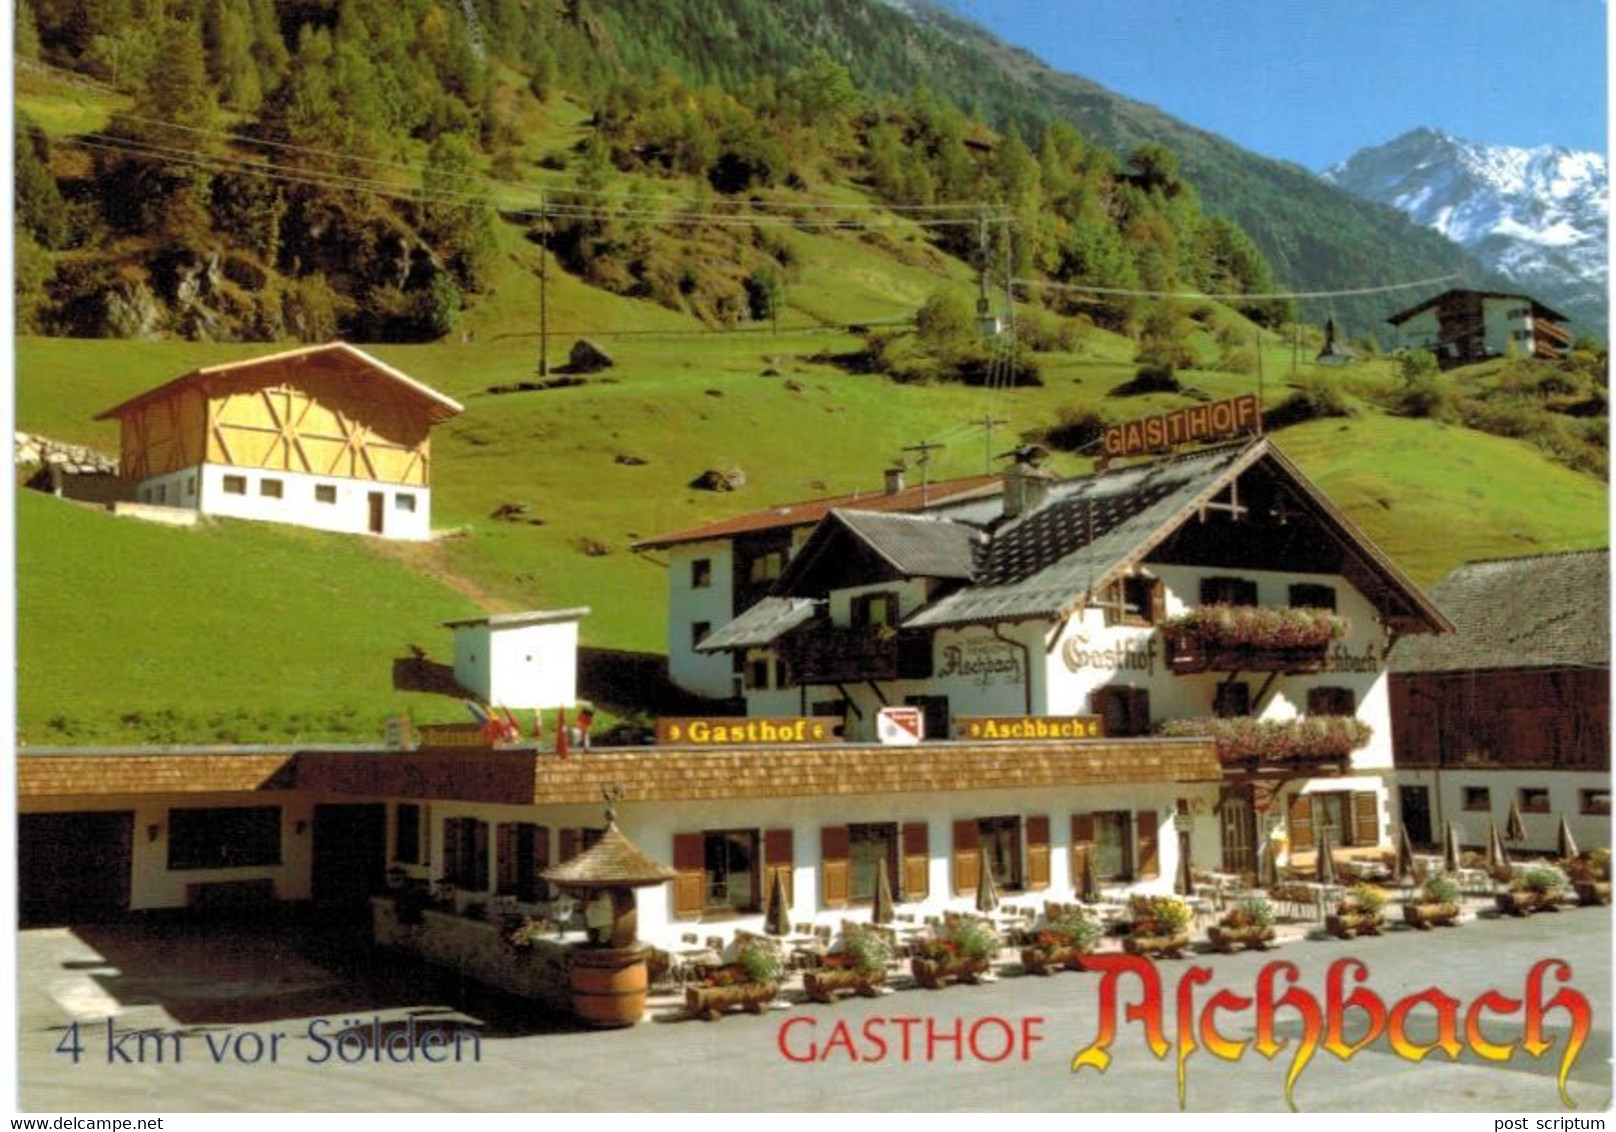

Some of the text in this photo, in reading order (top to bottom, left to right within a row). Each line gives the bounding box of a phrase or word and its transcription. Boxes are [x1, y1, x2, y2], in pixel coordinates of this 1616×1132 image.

[1105, 397, 1255, 454] GASTHOF
[1062, 634, 1158, 677] Gasthof
[688, 719, 1085, 743] Gasthof Aschbach
